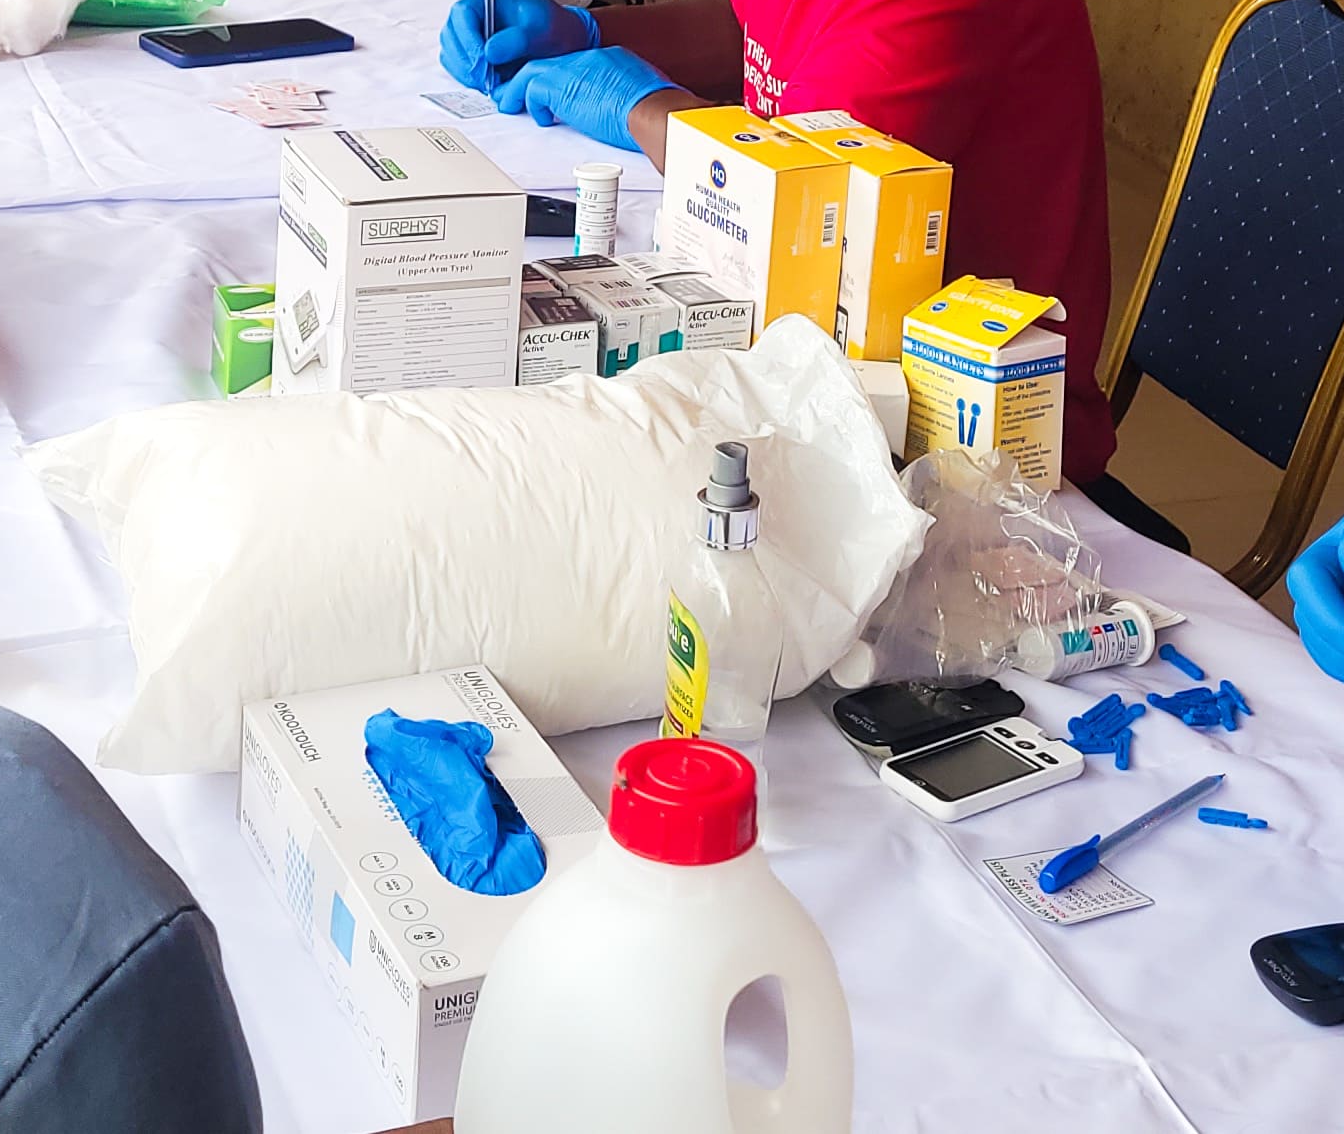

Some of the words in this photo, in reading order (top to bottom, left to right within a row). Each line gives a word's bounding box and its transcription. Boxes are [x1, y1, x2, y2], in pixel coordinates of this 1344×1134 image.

[711, 164, 725, 184] HQ
[695, 183, 717, 202] HUMAN
[718, 194, 741, 213] HEALTH
[705, 197, 730, 217] QUALITY
[368, 219, 439, 238] SURPHYS
[686, 198, 748, 245] GLUCOMETER
[363, 254, 397, 267] Digital
[398, 253, 427, 264] Blood
[429, 252, 469, 263] Pressure
[472, 249, 510, 259] Monitor
[398, 266, 427, 277] (Upper
[429, 266, 448, 275] Arm
[450, 264, 474, 274] Type)
[688, 306, 748, 322] ACCU-CHEK
[522, 329, 591, 346] ACCU-CHEK
[522, 344, 545, 354] Active
[464, 670, 519, 730] UNIGLOVES
[277, 705, 321, 763] KOOLTOUCH
